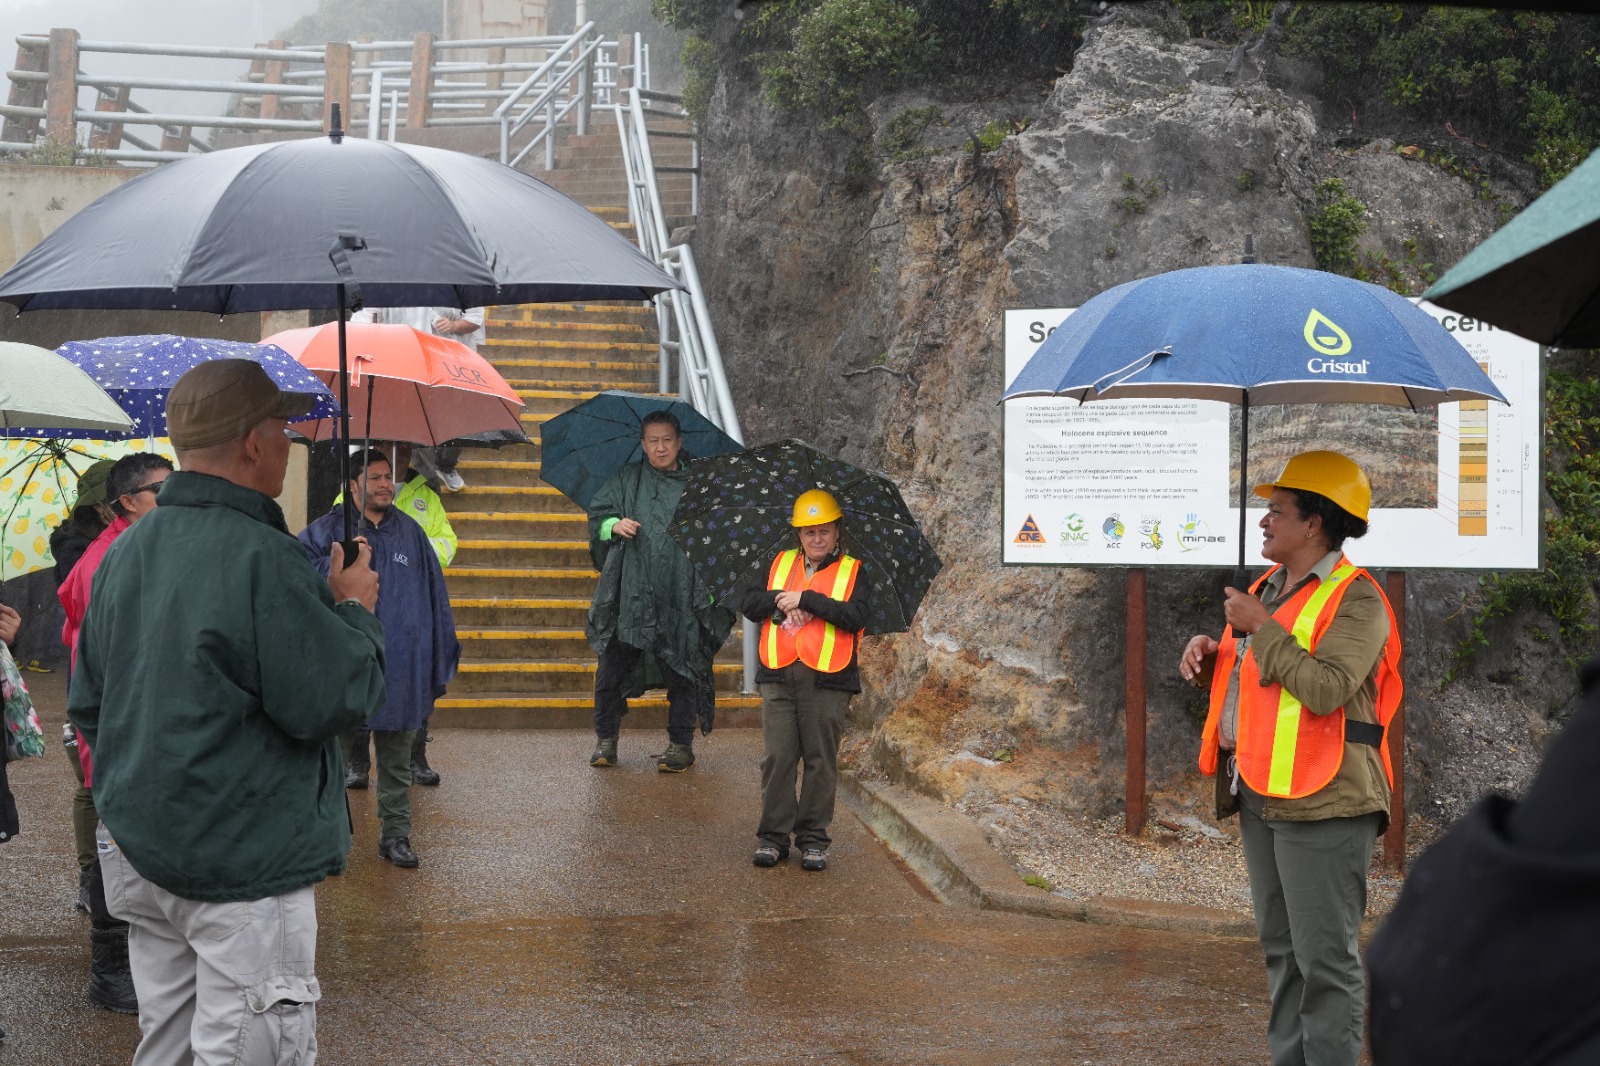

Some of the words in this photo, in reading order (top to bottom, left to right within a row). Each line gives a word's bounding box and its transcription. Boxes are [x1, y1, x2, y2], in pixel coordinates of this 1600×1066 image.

[1435, 314, 1493, 332] cen
[443, 361, 488, 384] UCR
[1307, 358, 1368, 374] Cristal
[1019, 533, 1040, 541] CNE
[1060, 532, 1089, 542] SINAC
